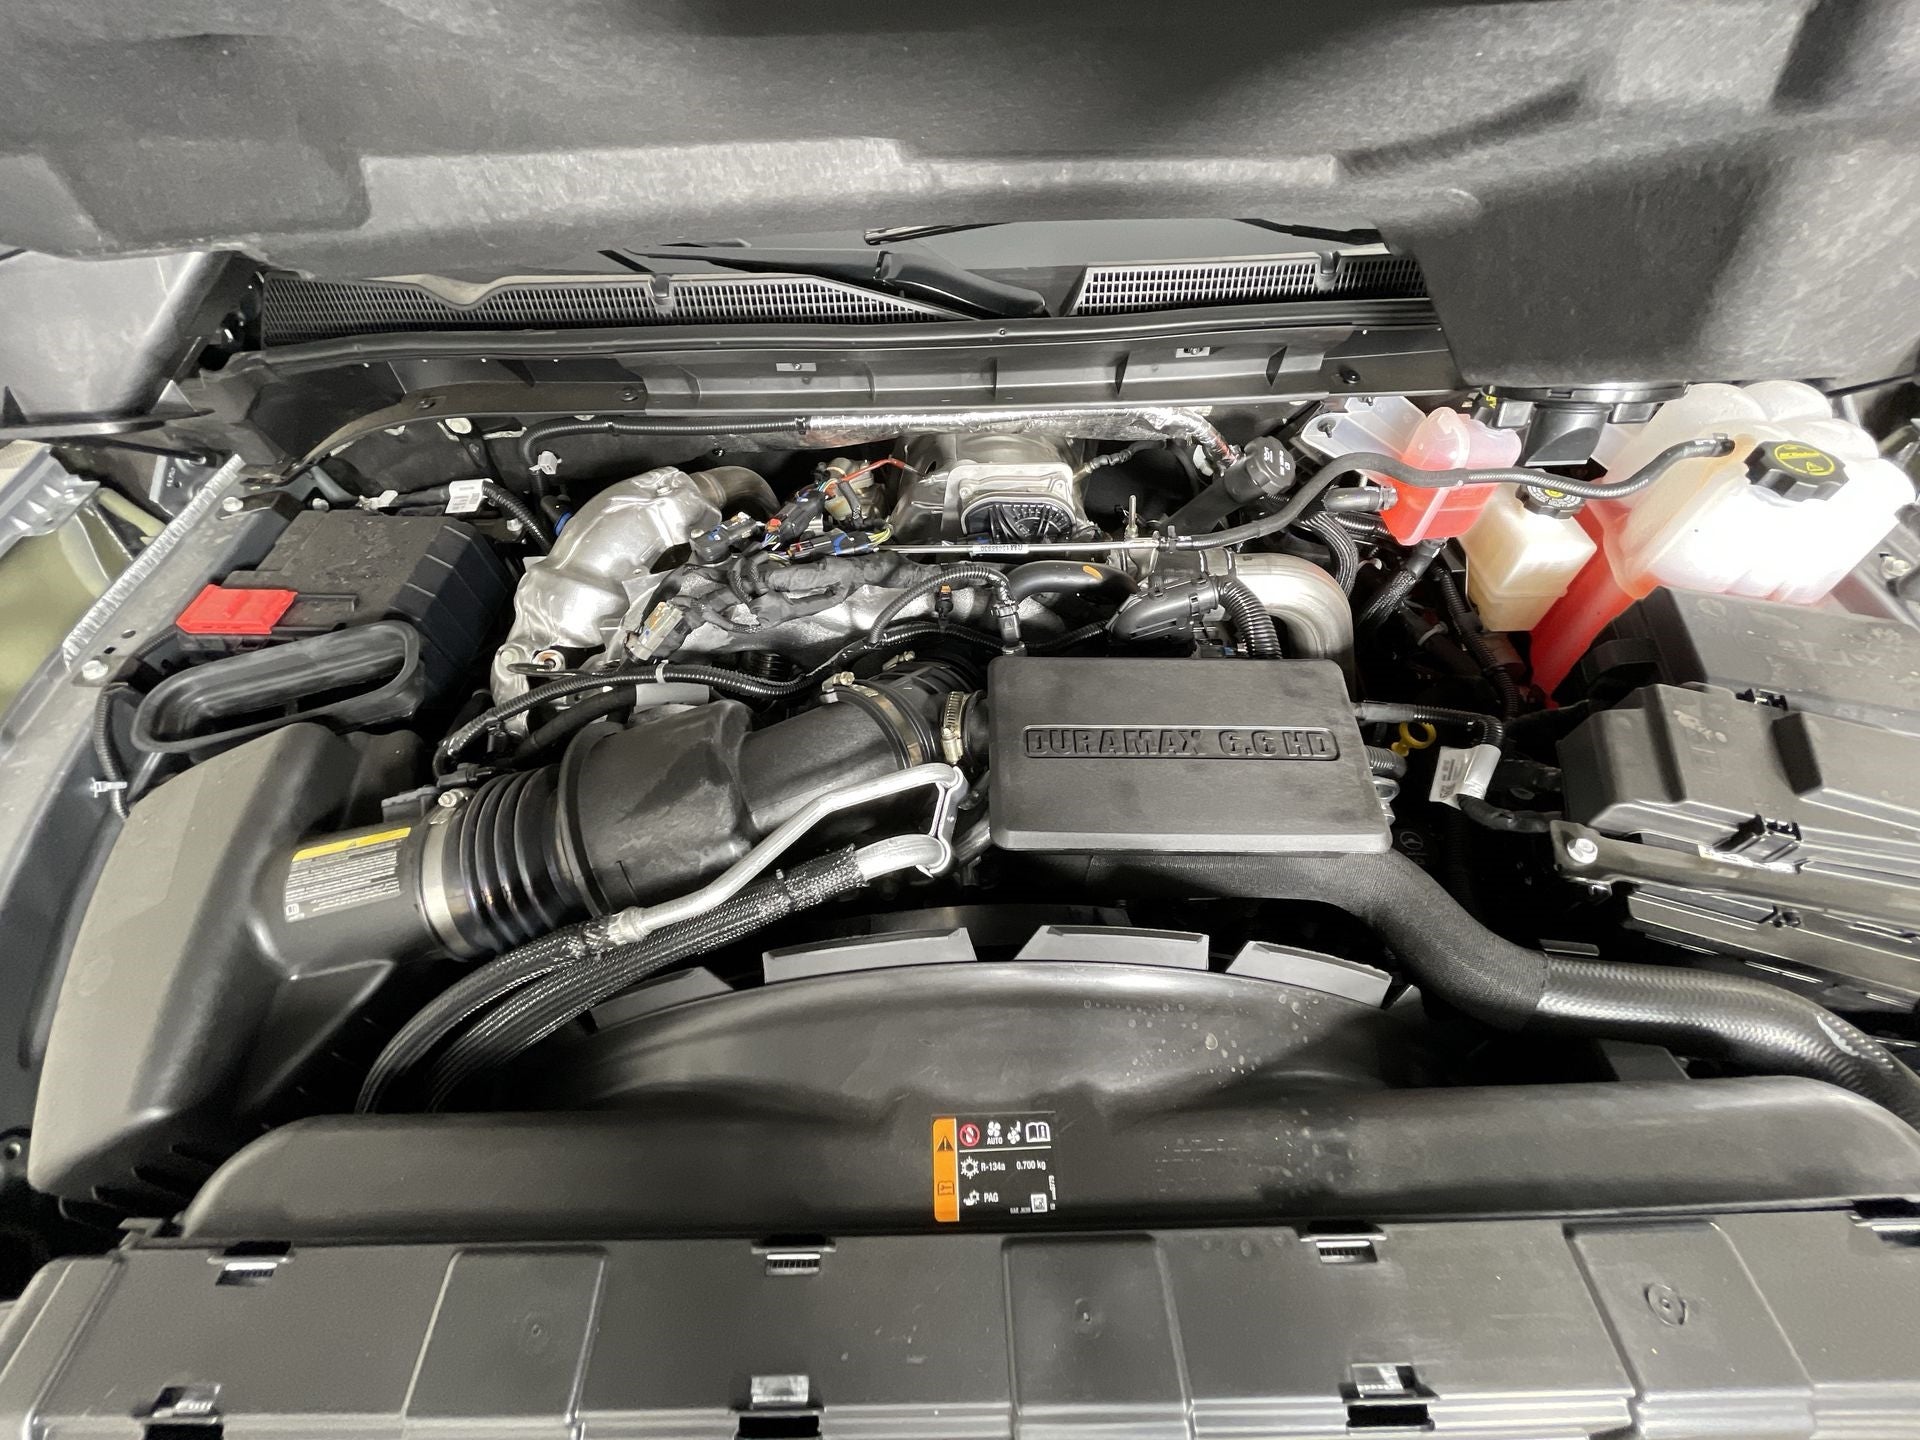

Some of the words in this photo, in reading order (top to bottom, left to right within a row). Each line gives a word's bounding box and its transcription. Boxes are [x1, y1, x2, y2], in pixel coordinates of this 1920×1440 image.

[1026, 730, 1206, 756] DURAMAX
[1218, 729, 1277, 757] 6.6
[1283, 730, 1335, 757] HD
[986, 1136, 1003, 1145] AUTO
[981, 1161, 1006, 1171] R-134a
[1016, 1159, 1036, 1170] 0.700
[1036, 1159, 1046, 1171] kg
